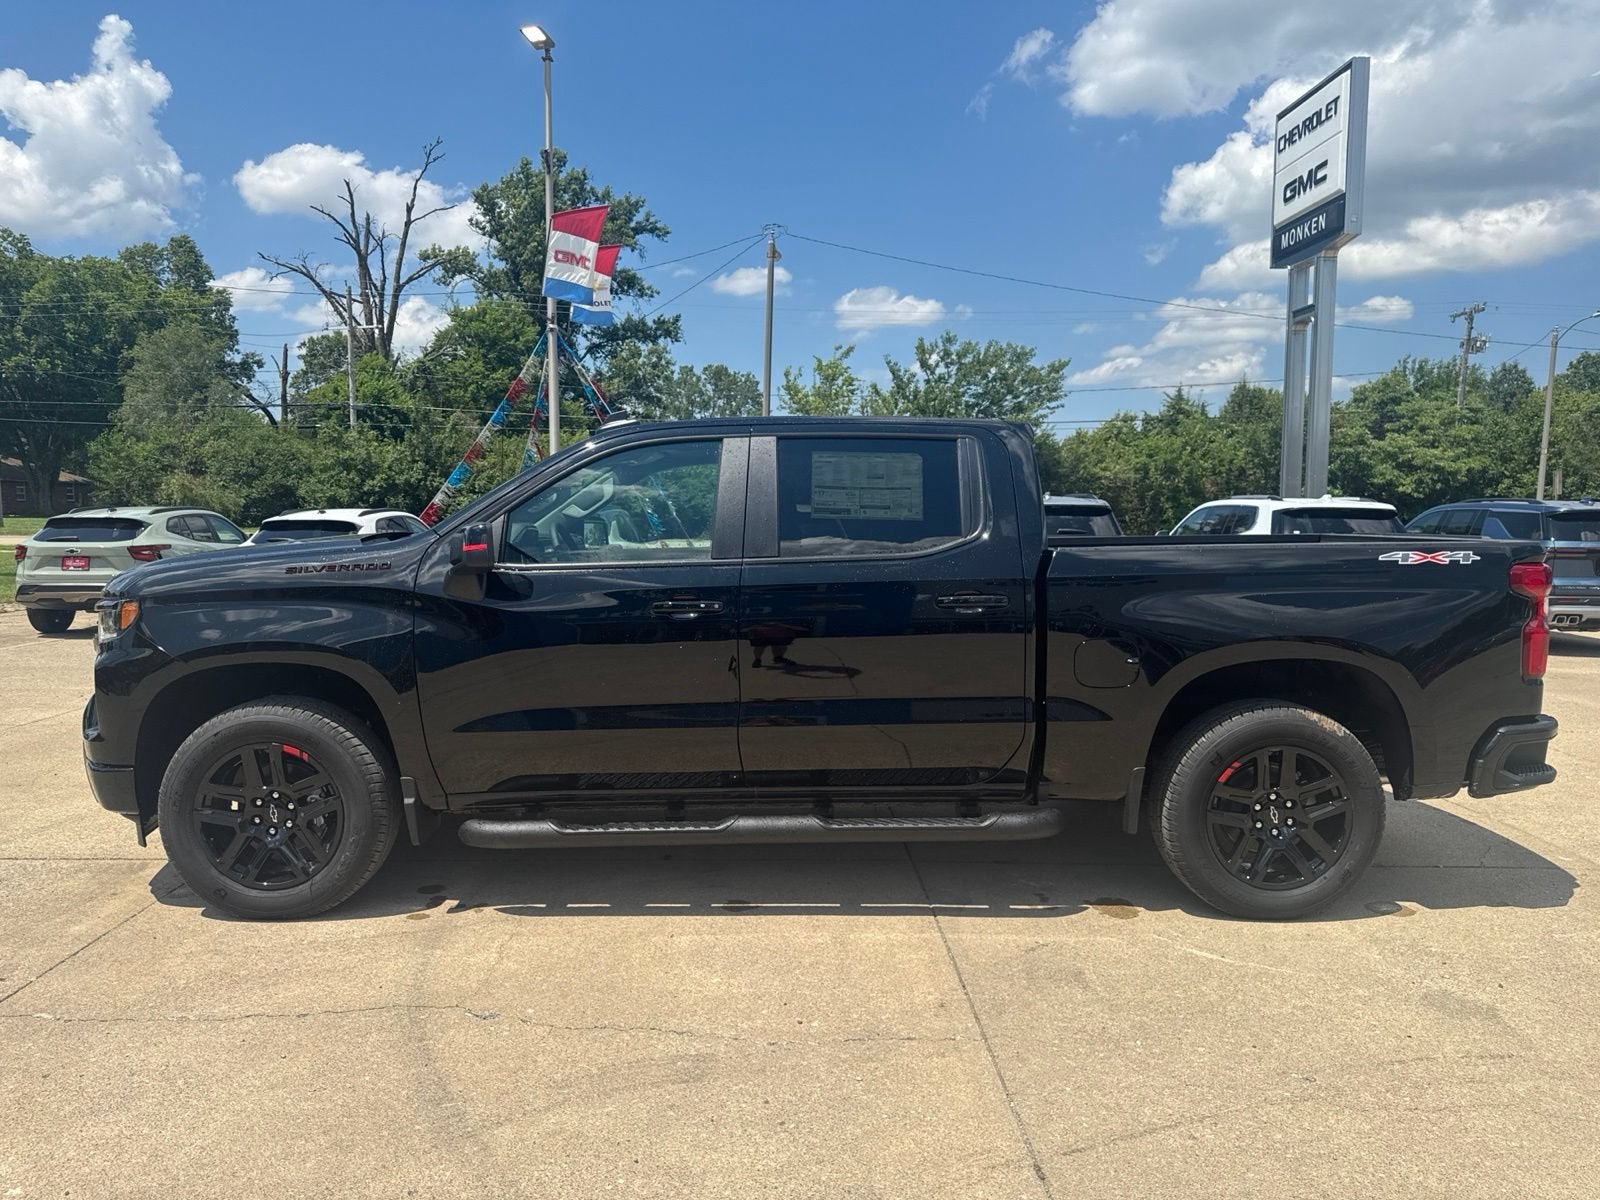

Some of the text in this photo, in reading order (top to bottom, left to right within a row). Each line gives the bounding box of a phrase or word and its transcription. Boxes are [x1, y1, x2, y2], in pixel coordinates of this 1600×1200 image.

[1277, 95, 1340, 154] CHEVROLET
[1283, 160, 1328, 204] GMC
[1280, 213, 1326, 250] MONKEN
[553, 250, 591, 271] GMC
[284, 562, 392, 575] SILVERADO
